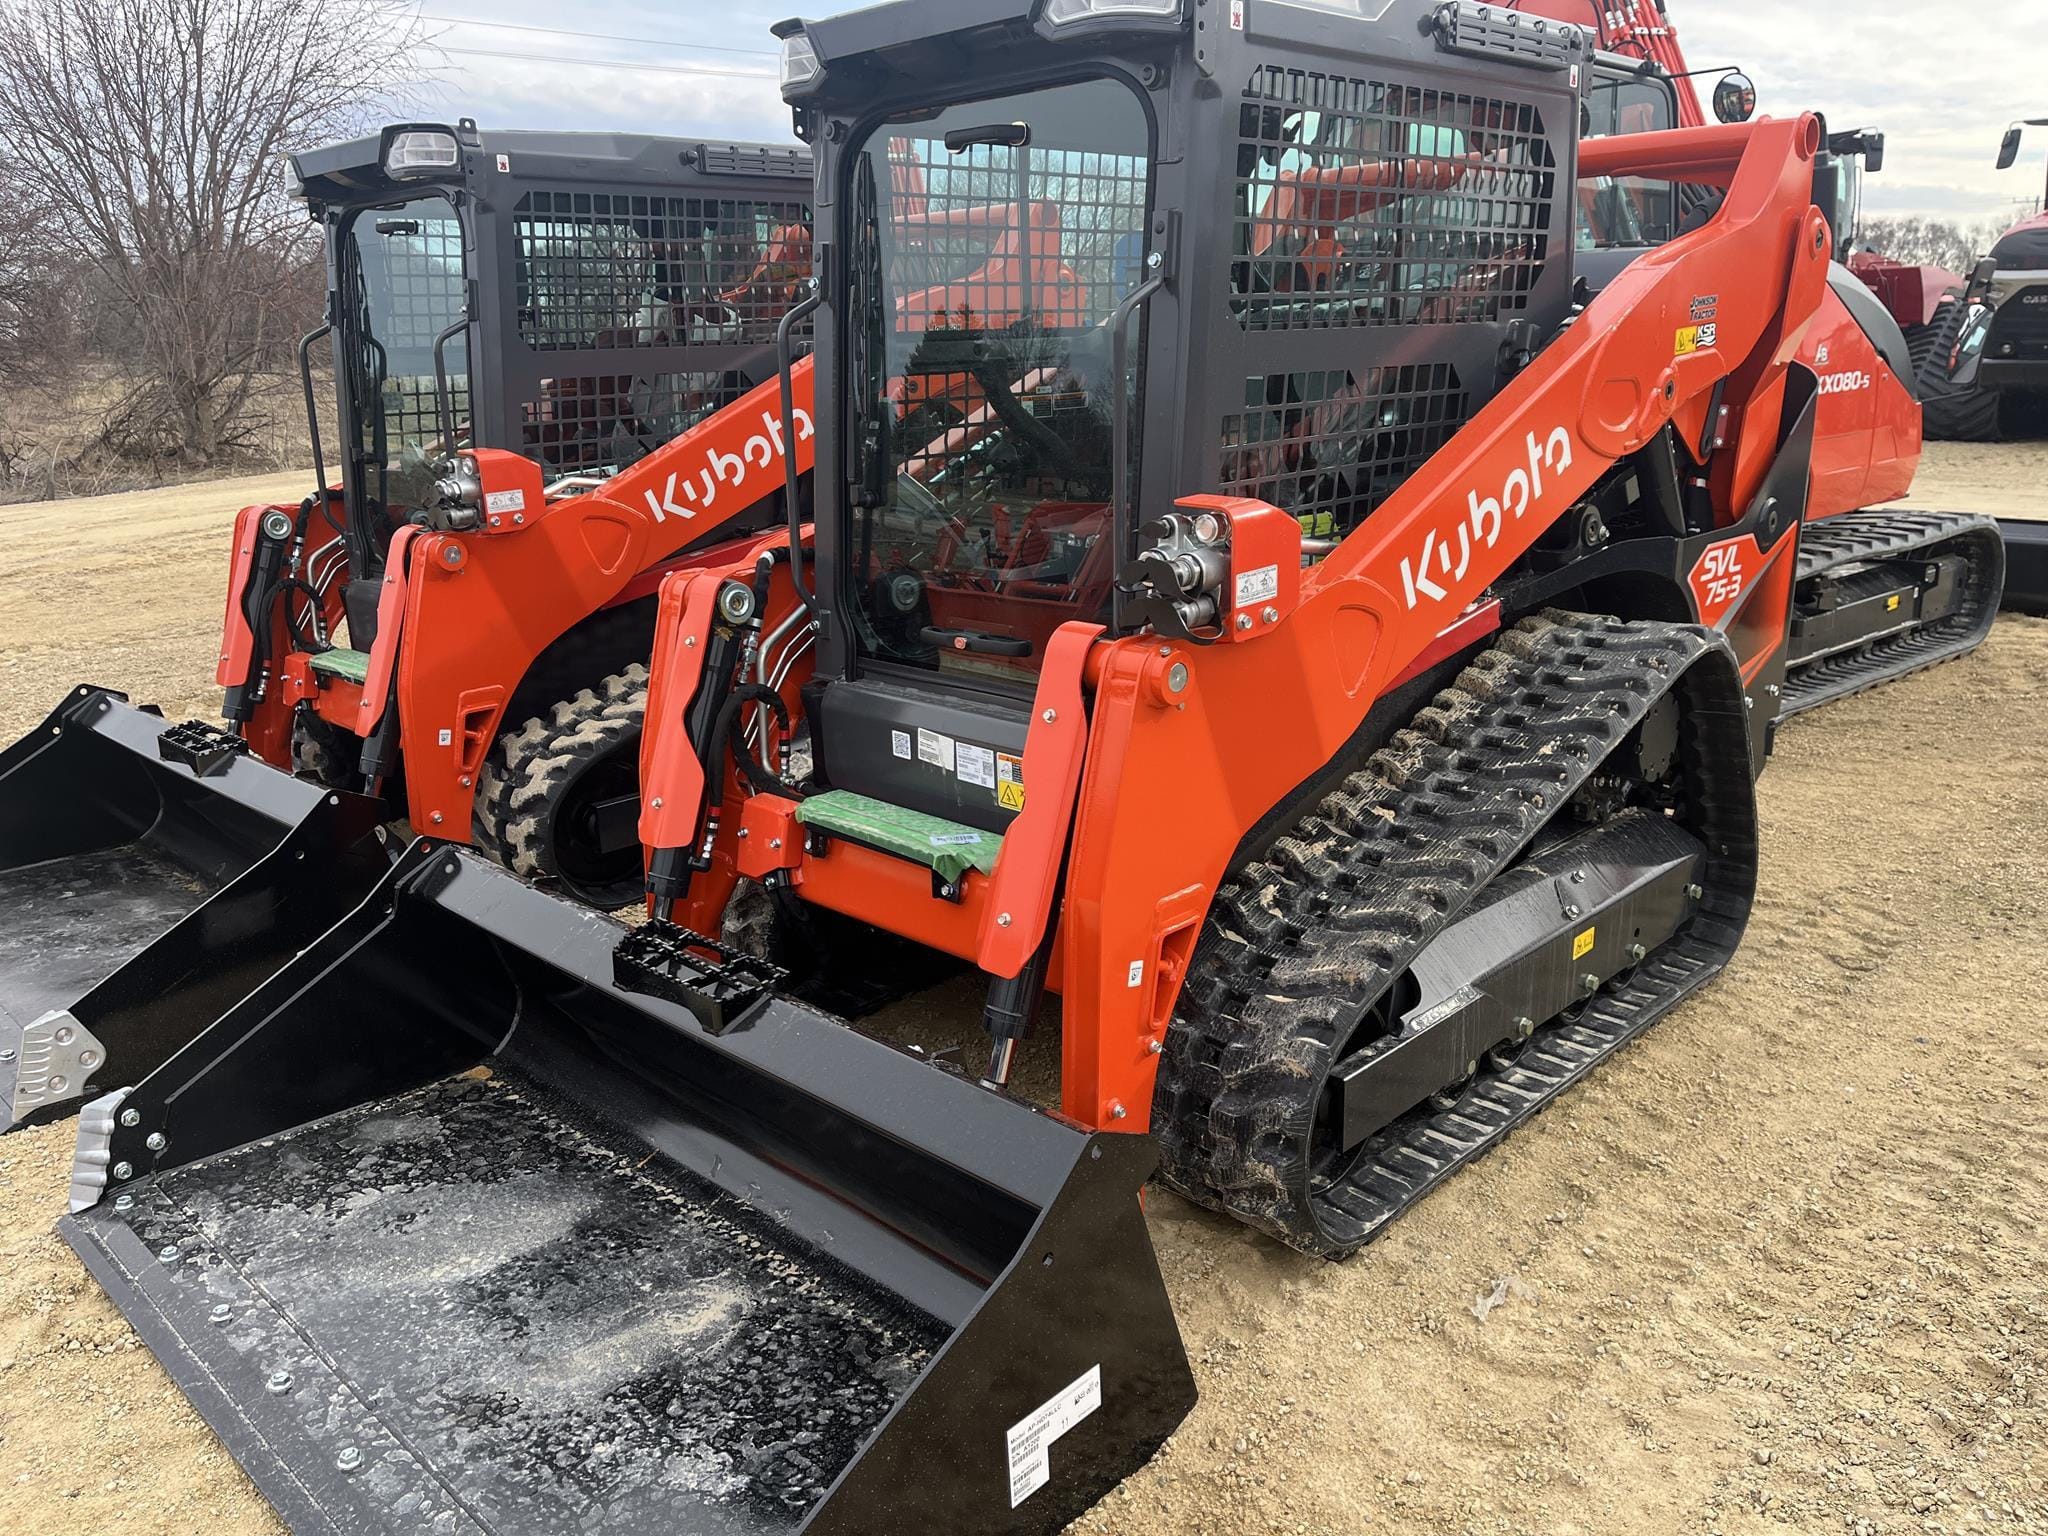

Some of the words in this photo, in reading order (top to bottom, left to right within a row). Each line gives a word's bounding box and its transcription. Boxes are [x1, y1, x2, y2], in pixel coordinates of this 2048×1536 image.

[1690, 295, 1717, 308] JOHNSON
[1690, 308, 1717, 321] TRACTOR
[1697, 323, 1716, 338] KSR
[644, 408, 815, 524] Kubota
[1400, 426, 1572, 610] Kubota
[1700, 544, 1742, 582] SVL
[1705, 574, 1742, 607] 75-3
